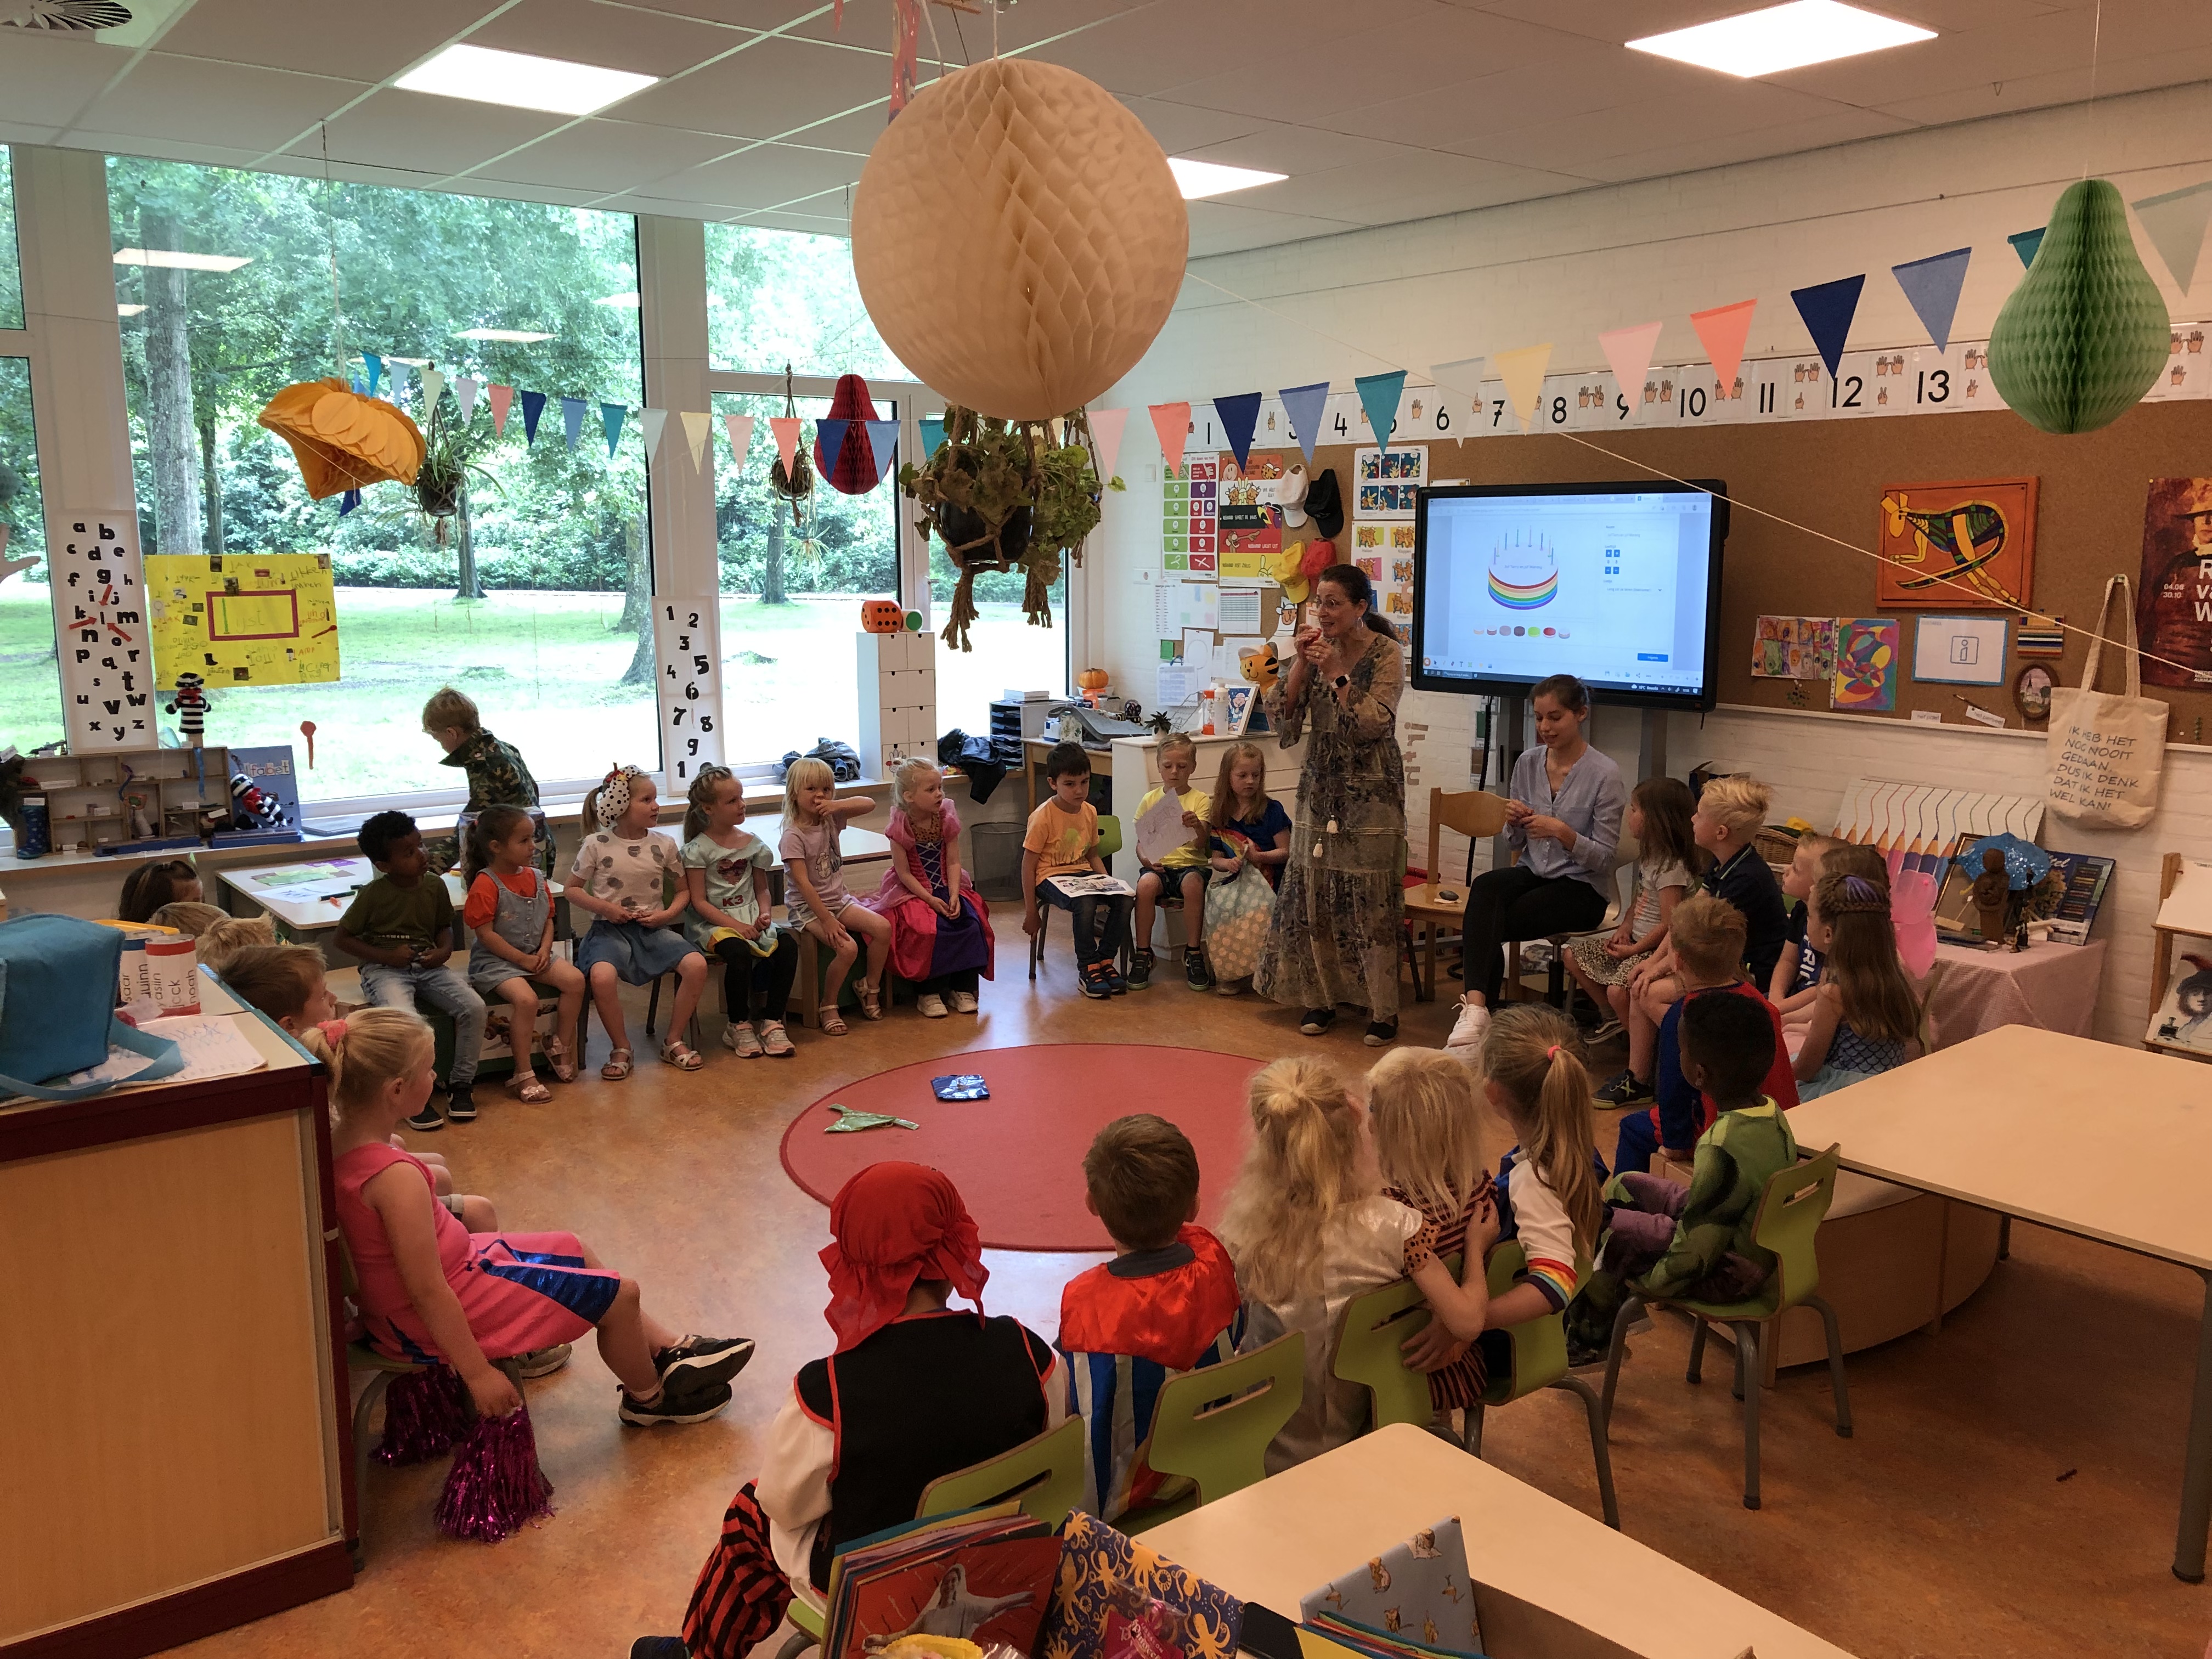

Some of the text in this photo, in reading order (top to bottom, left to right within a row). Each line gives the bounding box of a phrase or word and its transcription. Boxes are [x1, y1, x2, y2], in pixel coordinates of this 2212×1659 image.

[1334, 412, 1347, 437] 4
[1436, 405, 1450, 431] 6
[1492, 400, 1505, 427] 7
[1551, 396, 1567, 424] 8
[1679, 387, 1707, 418] 10
[1759, 382, 1775, 413] 11
[1832, 376, 1863, 408] 12
[1916, 369, 1950, 404] 13
[73, 523, 115, 540] a b
[66, 544, 125, 560] c d e
[67, 569, 133, 586] f g h
[88, 590, 120, 605] i j
[75, 605, 86, 619] k
[117, 611, 139, 624] m
[666, 606, 699, 628] 1 2
[81, 629, 122, 646] n o
[679, 635, 690, 651] 3
[76, 650, 139, 670] p q r
[667, 654, 709, 679] 4 5
[93, 672, 134, 691] s t
[685, 682, 699, 700] 6
[77, 693, 146, 715] u v w
[673, 707, 713, 732] 7 8
[88, 720, 144, 741] x y z
[2069, 725, 2138, 747] IK HEB HET
[687, 738, 699, 756] 9
[2087, 747, 2134, 760] NOOIT
[242, 761, 289, 776] lfabet
[2057, 763, 2139, 788] DUS IK DENK
[2053, 776, 2125, 799] DAT IK HET
[2050, 788, 2112, 811] WEL KAN!
[722, 894, 744, 907] K3
[185, 969, 196, 1004] noah
